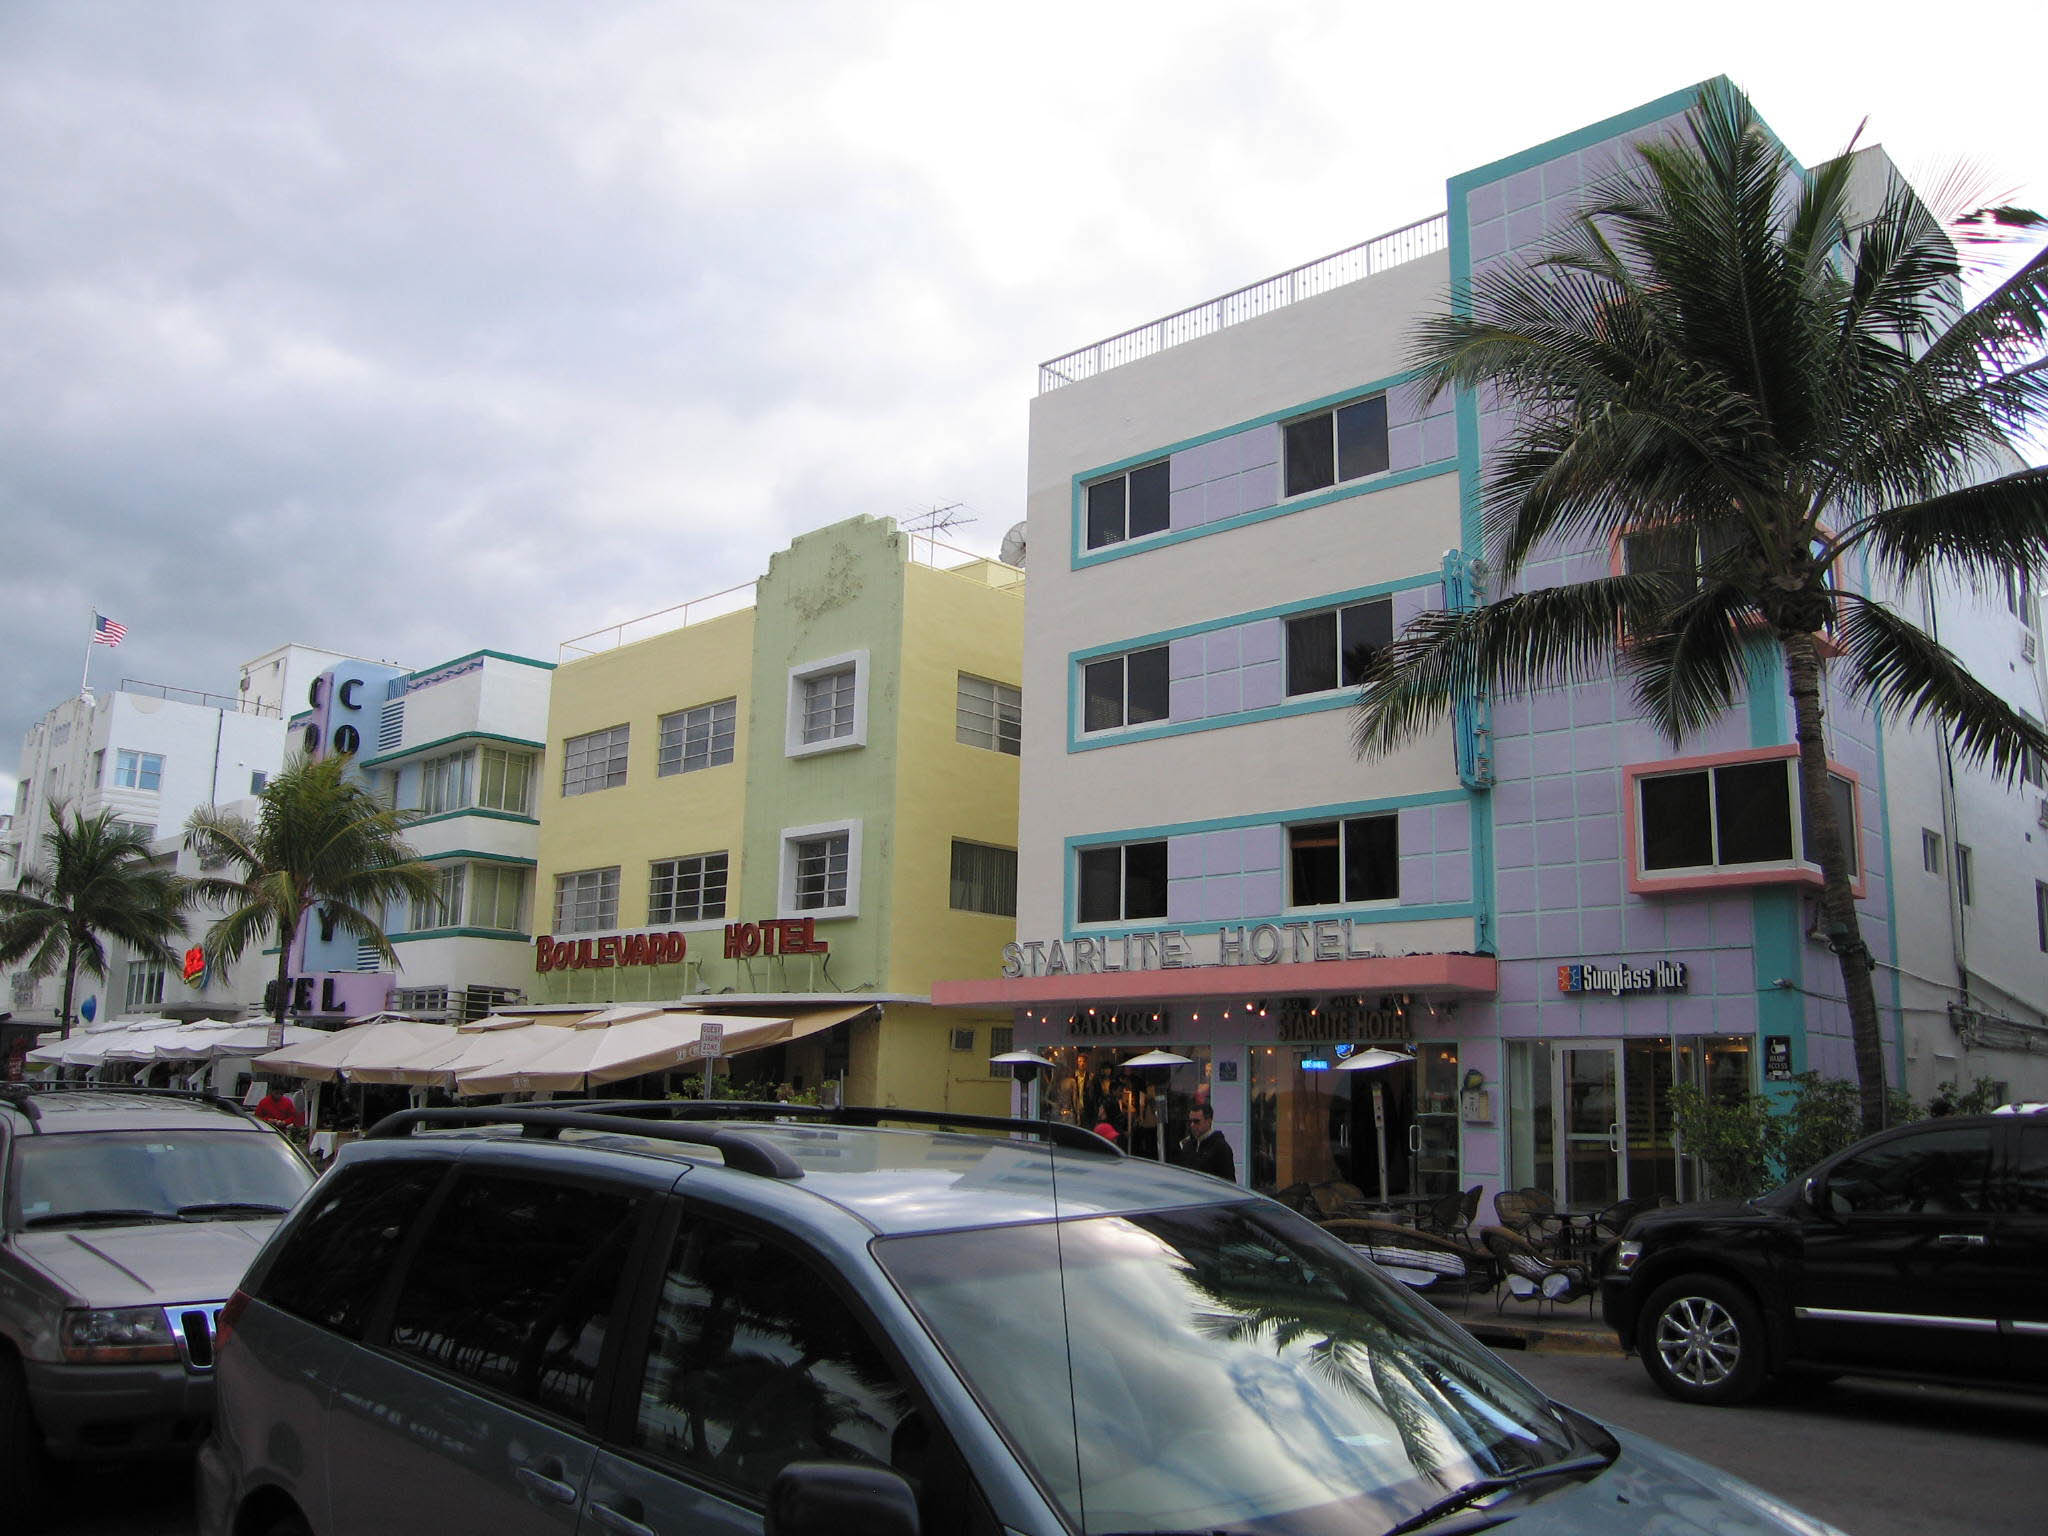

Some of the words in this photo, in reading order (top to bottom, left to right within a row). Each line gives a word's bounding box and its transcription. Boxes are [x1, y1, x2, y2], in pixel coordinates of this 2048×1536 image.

[536, 934, 687, 973] BOULEVARD
[723, 917, 829, 960] HOTEL
[1001, 930, 1188, 979] STARLITE
[1217, 918, 1372, 966] HOTEL
[1583, 964, 1651, 996] Sunglass
[1656, 960, 1684, 988] Hut
[1278, 1010, 1350, 1042] STARLITE
[1354, 1009, 1412, 1039] HOTEL
